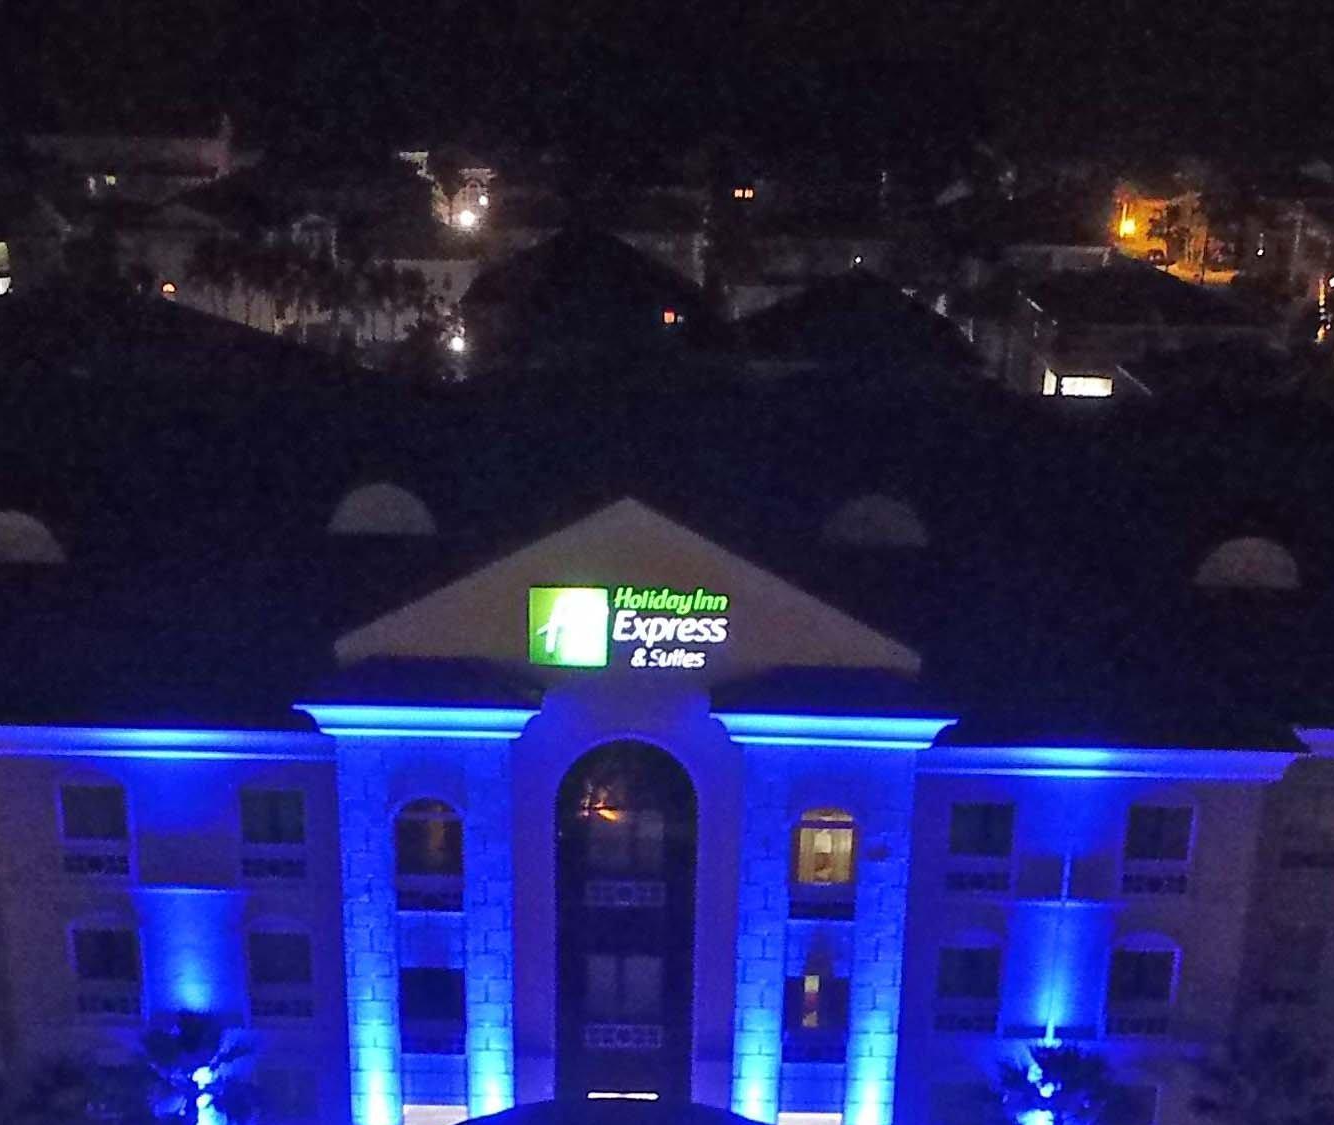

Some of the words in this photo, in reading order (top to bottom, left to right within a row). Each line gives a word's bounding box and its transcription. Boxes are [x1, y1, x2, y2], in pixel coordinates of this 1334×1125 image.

[615, 587, 693, 614] Holiday
[694, 589, 728, 610] Inn
[613, 610, 728, 647] Express
[630, 649, 646, 667] &
[649, 648, 705, 668] Suites
